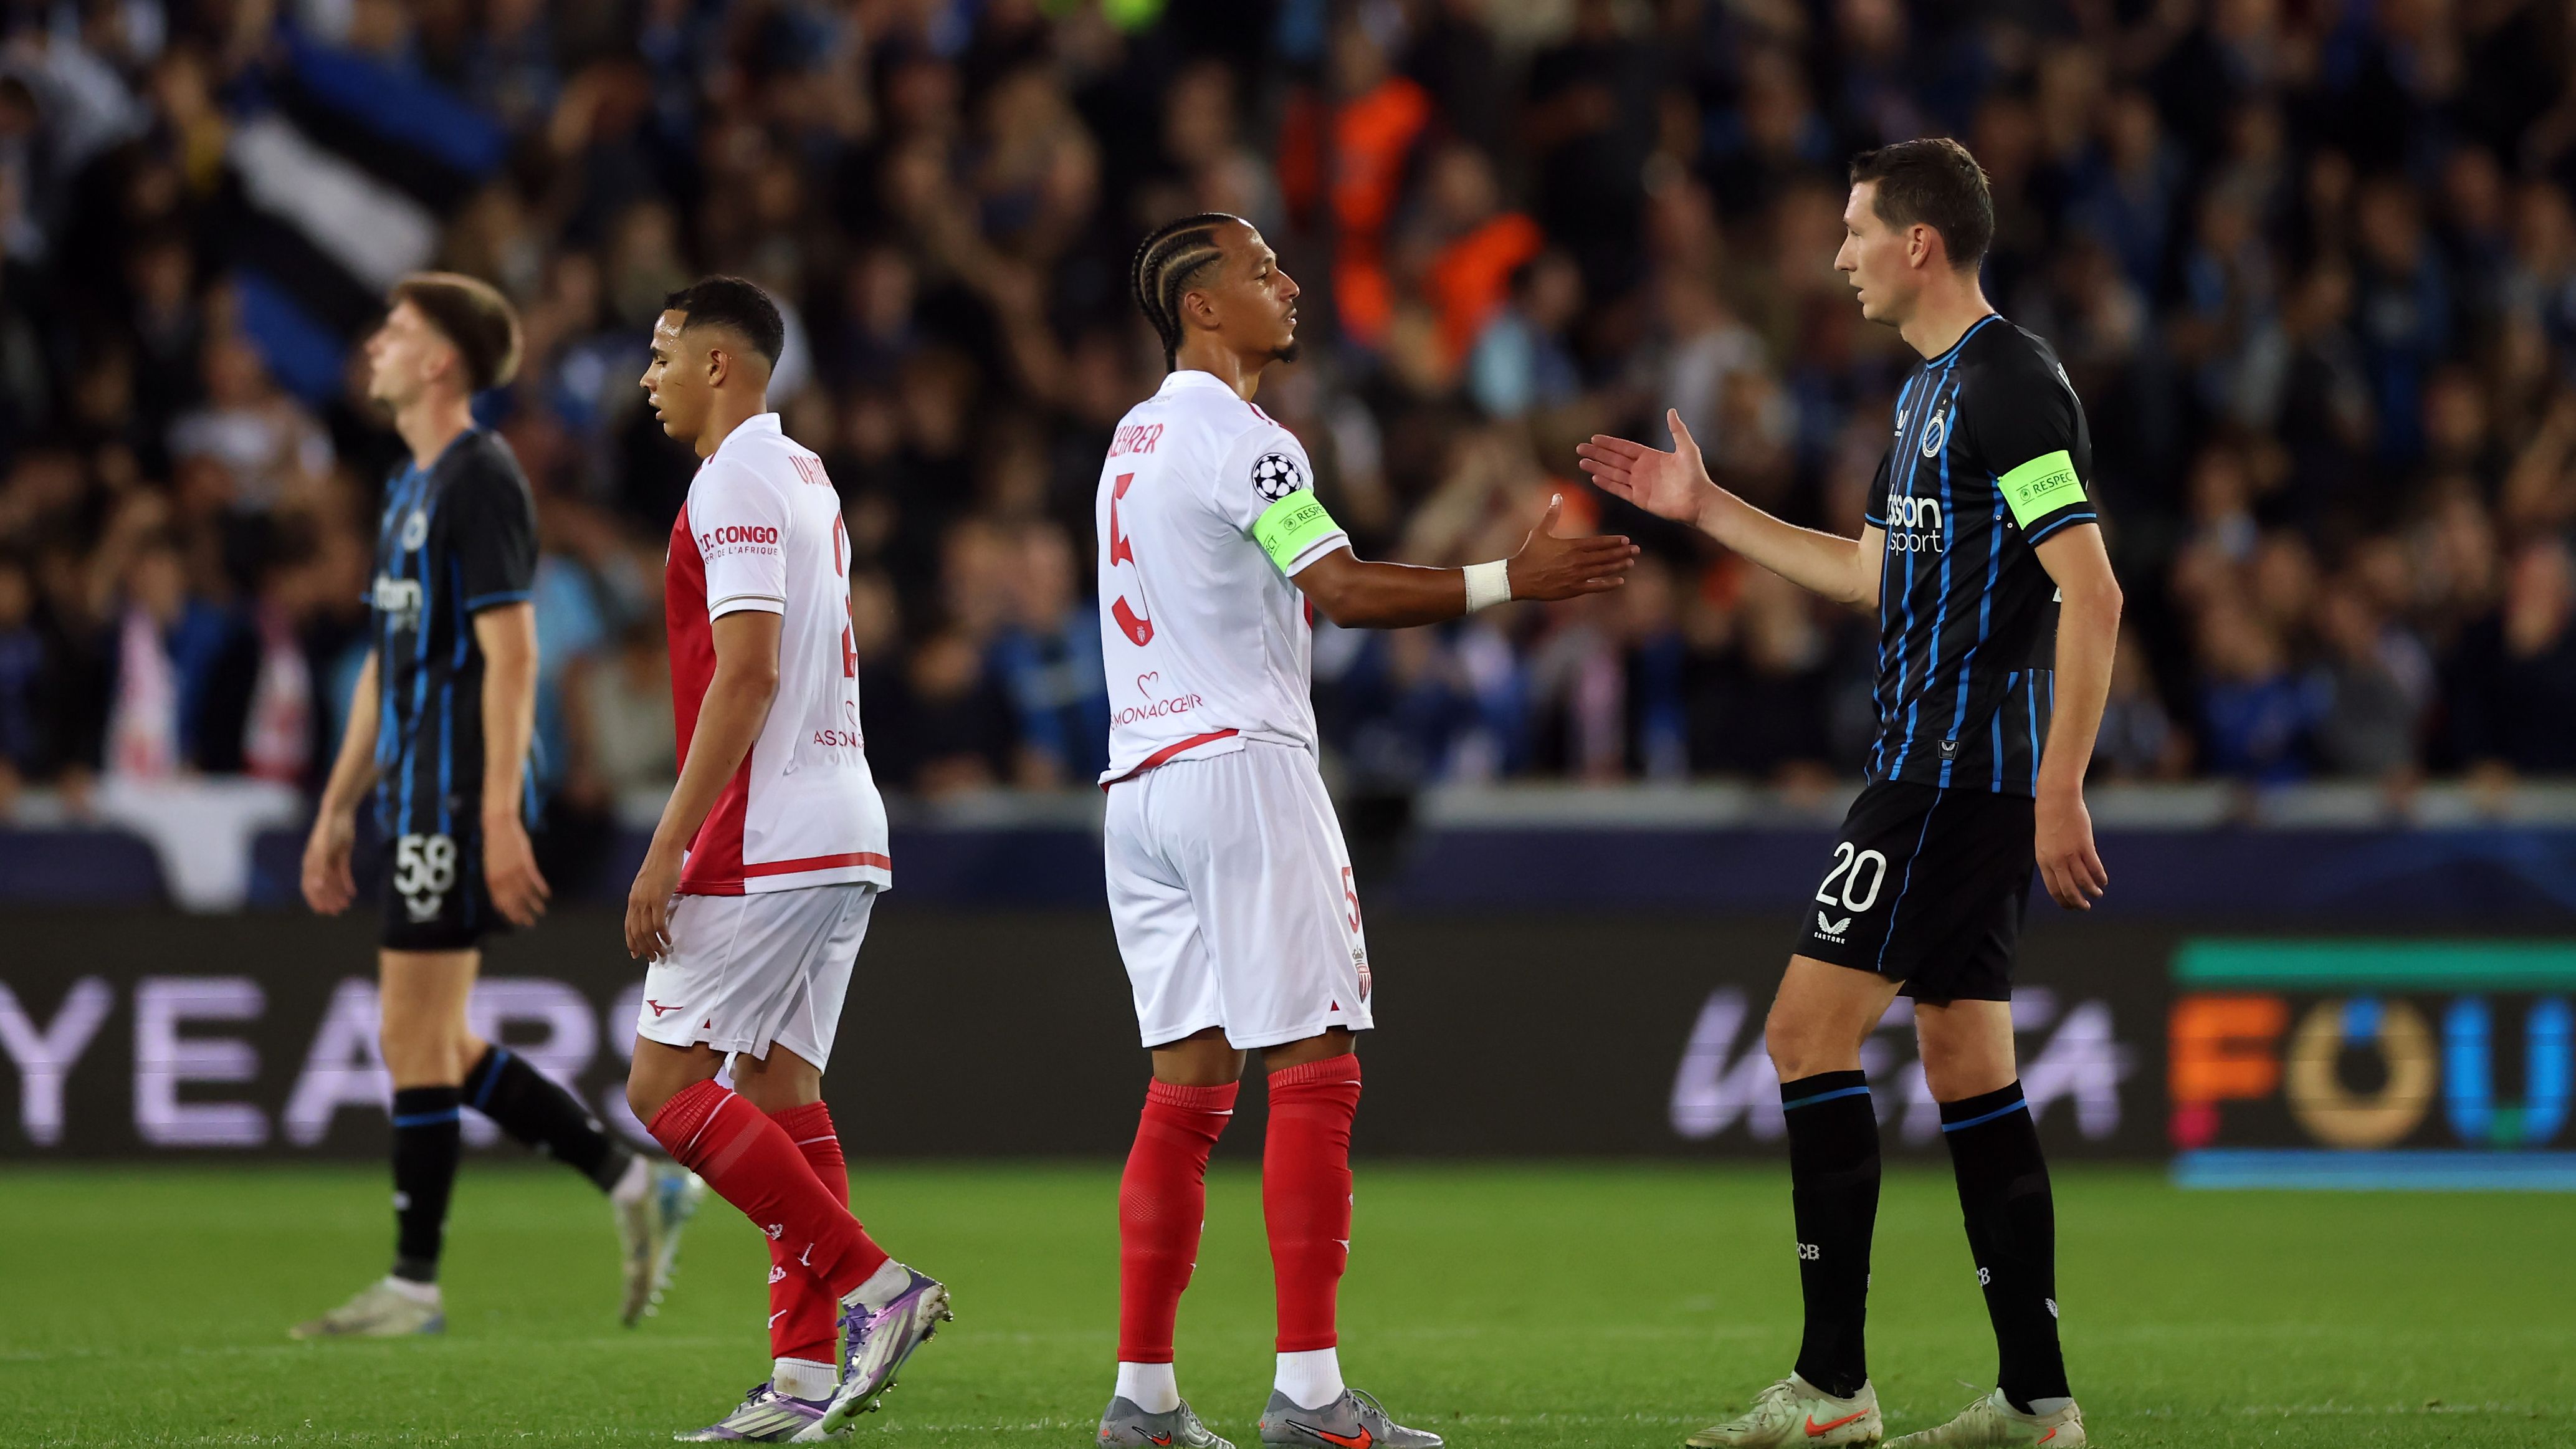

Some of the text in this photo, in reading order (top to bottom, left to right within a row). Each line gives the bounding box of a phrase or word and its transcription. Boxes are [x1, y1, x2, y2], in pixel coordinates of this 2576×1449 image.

[715, 525, 778, 545] CONGO
[728, 546, 778, 556] L'AFRIQUE
[1110, 472, 1155, 647] 5
[394, 833, 457, 897] 58
[1815, 841, 1887, 912] 20
[1341, 866, 1361, 934] 5
[1813, 931, 1846, 945] CASTORE
[1796, 1241, 1820, 1261] CB
